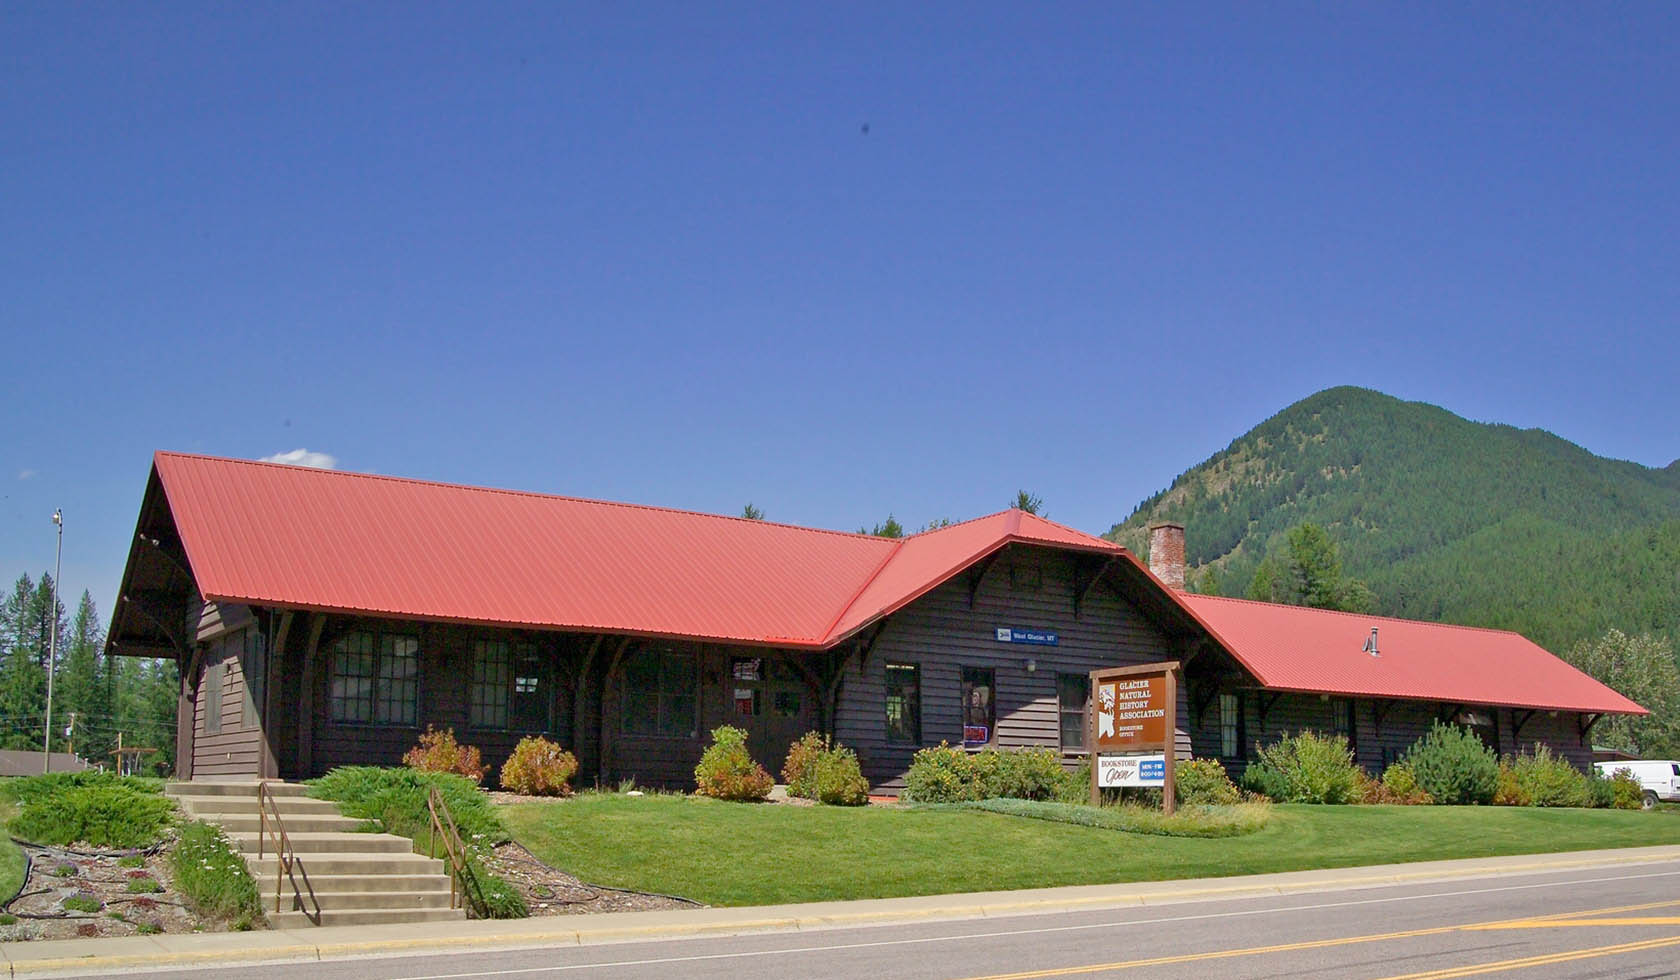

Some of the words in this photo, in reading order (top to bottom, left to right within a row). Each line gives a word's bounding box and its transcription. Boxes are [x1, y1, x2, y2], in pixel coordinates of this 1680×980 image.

[1119, 680, 1149, 690] GLACIER
[1119, 690, 1152, 700] NATURAL
[1119, 701, 1148, 710] HISTORY
[1119, 709, 1165, 720] ASSOCIATION
[1106, 767, 1134, 784] Open
